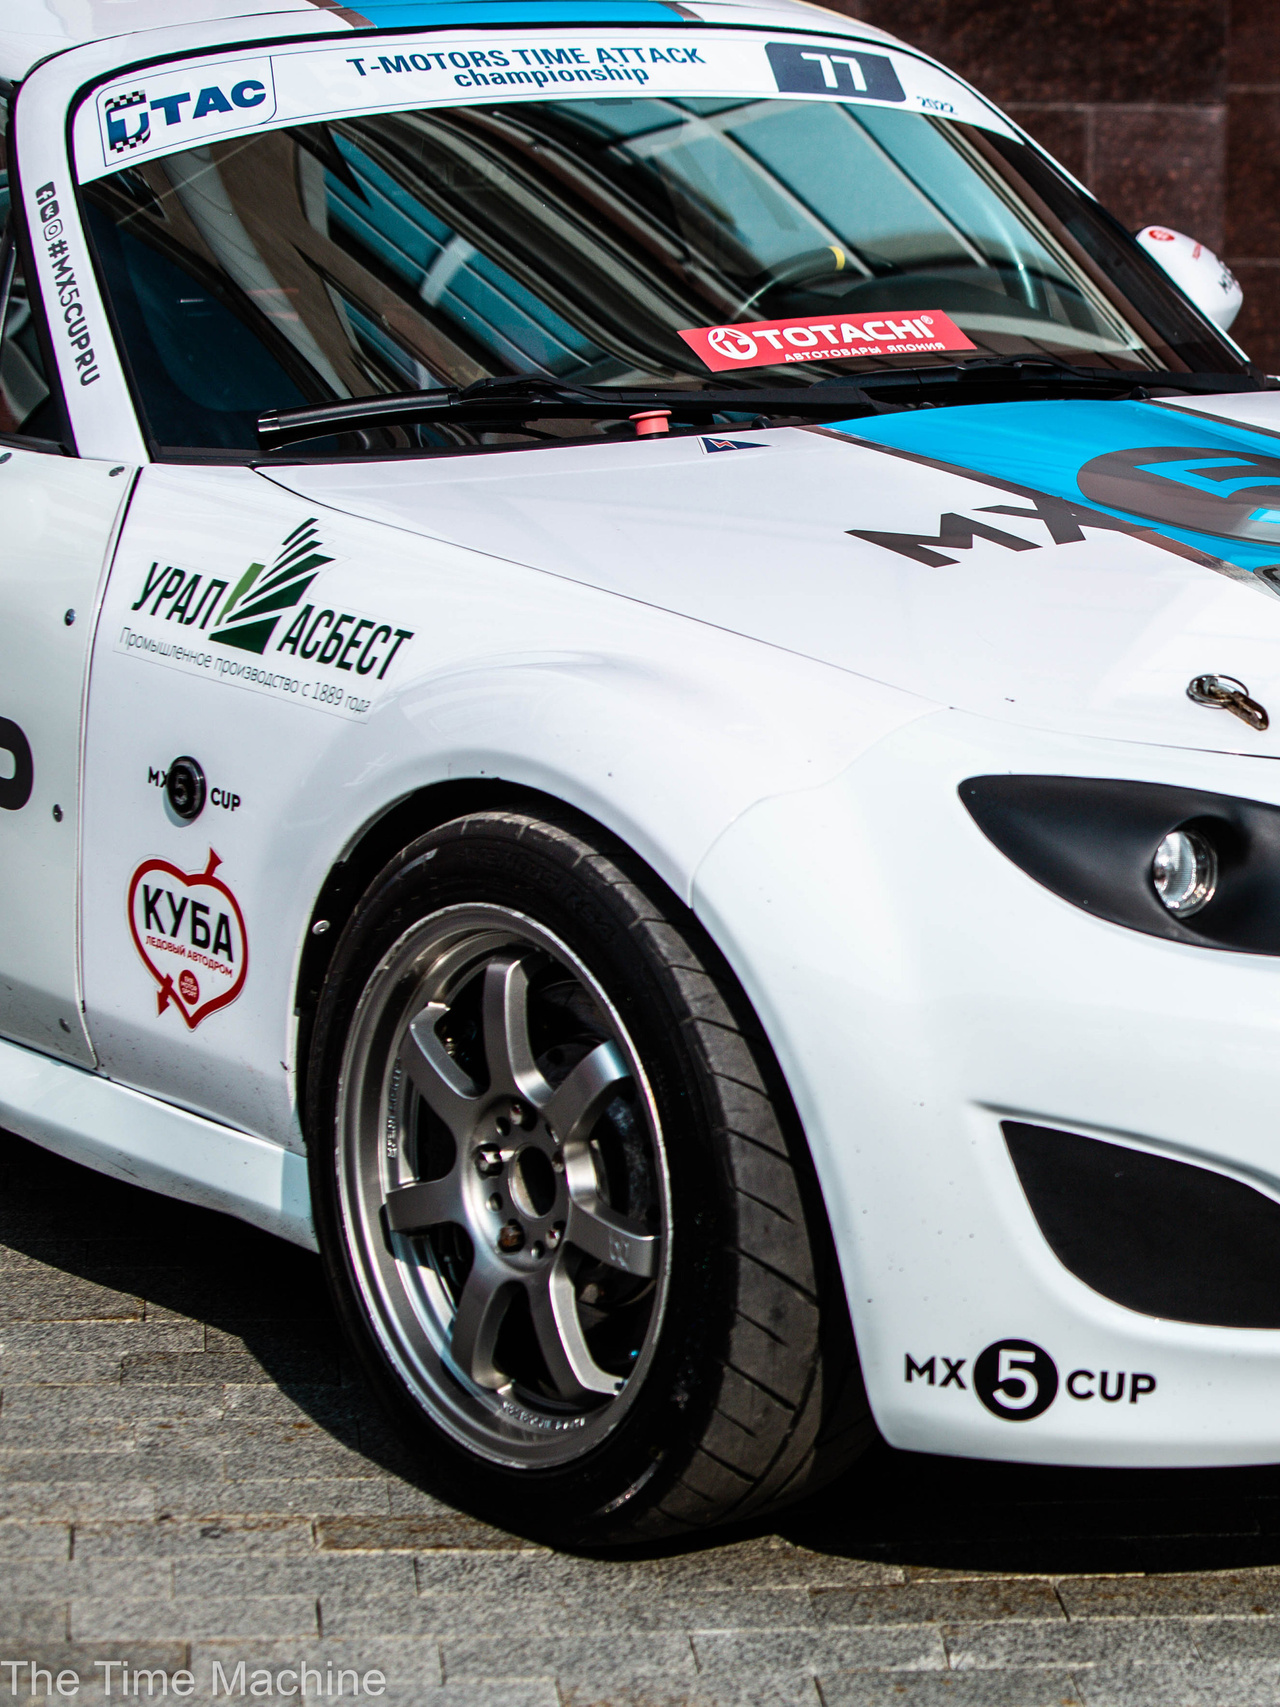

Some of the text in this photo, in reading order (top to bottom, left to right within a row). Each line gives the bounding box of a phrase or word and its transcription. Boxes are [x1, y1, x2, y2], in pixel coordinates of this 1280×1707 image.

[346, 47, 708, 76] T-MOTORS TIME ATTACK
[454, 63, 650, 88] championship
[801, 52, 867, 91] 77
[916, 96, 958, 115] 2022
[753, 318, 935, 350] TOTACHI
[785, 342, 945, 362] АВТОТОВАРЫ ЯПОНИЯ
[844, 496, 1159, 568] MX
[131, 562, 415, 680] УРАЛ АСБЕСТ
[119, 626, 213, 668] Промышленное
[213, 657, 299, 694] производство
[301, 683, 310, 697] с
[312, 681, 344, 706] 1889
[210, 787, 241, 812] CUP
[142, 884, 234, 963] КУБА
[146, 935, 233, 978] ЛЕДОВЫЙ АВТОДРОМ
[904, 1349, 1157, 1410] MX 5 CUP
